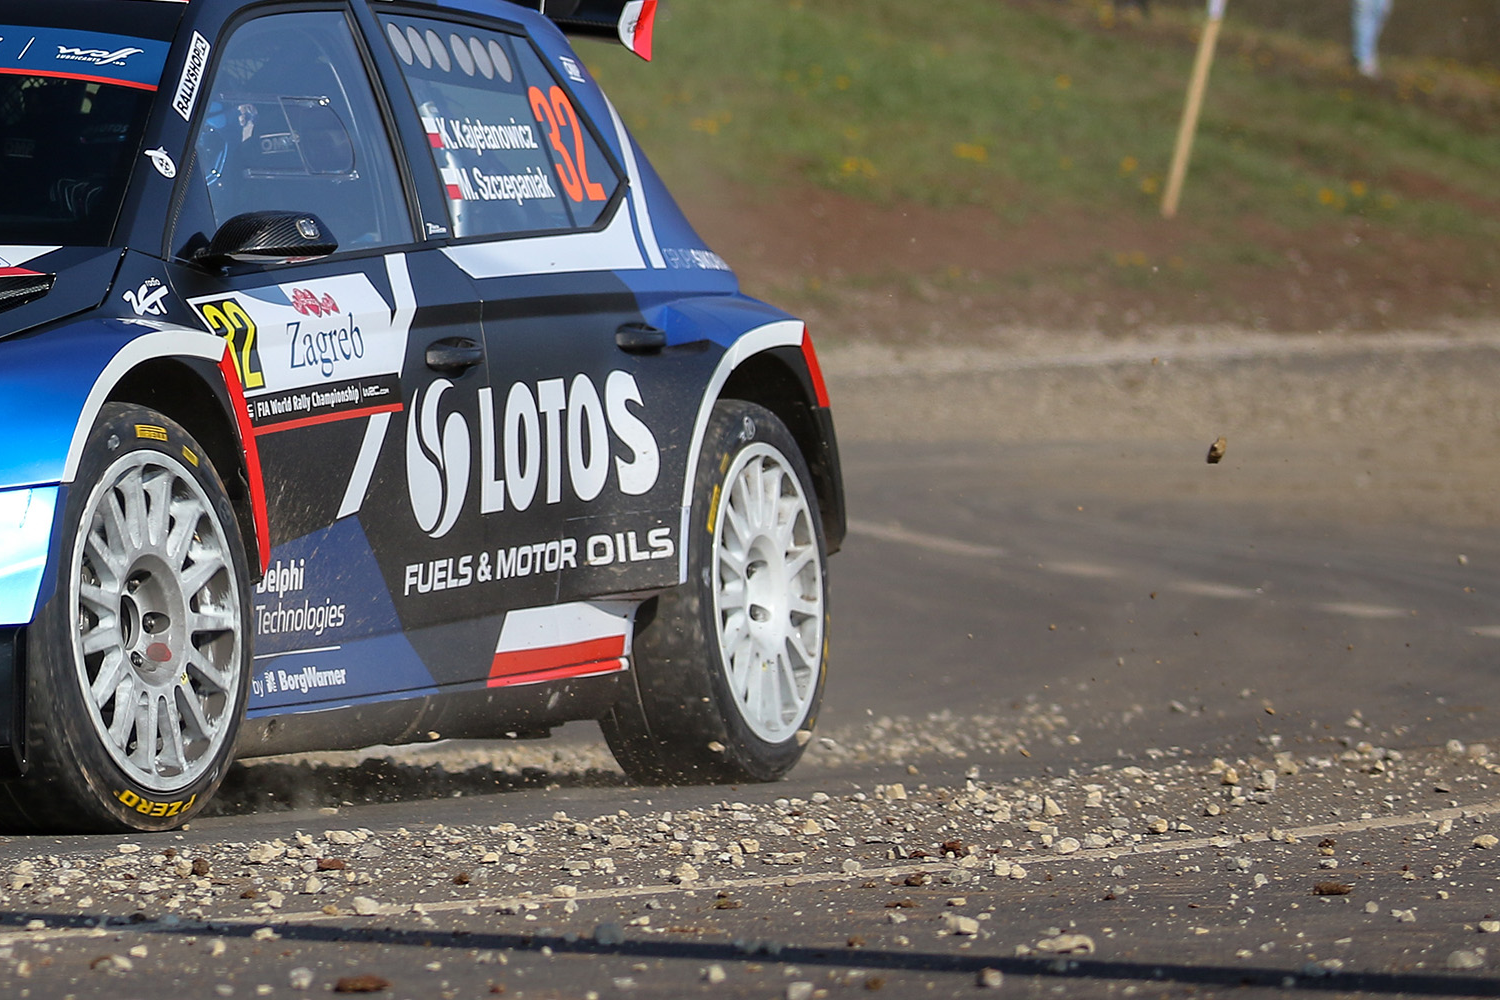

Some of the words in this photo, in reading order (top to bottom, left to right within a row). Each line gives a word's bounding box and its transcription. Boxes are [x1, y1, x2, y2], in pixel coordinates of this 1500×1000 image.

[528, 85, 607, 203] 32
[457, 168, 480, 201] M.
[472, 166, 556, 206] Szczepaniak
[287, 312, 365, 377] Zagreb
[257, 402, 271, 418] FIA
[270, 396, 292, 415] World
[293, 393, 311, 412] Rally
[311, 385, 359, 408] Championship
[478, 369, 661, 515] LOTOS
[404, 555, 473, 596] FUELS
[476, 552, 492, 582] &
[496, 538, 577, 580] MOTOR
[587, 527, 675, 566] OILS
[255, 598, 346, 636] Technologies
[252, 677, 264, 697] by
[277, 665, 347, 694] BorgWarner
